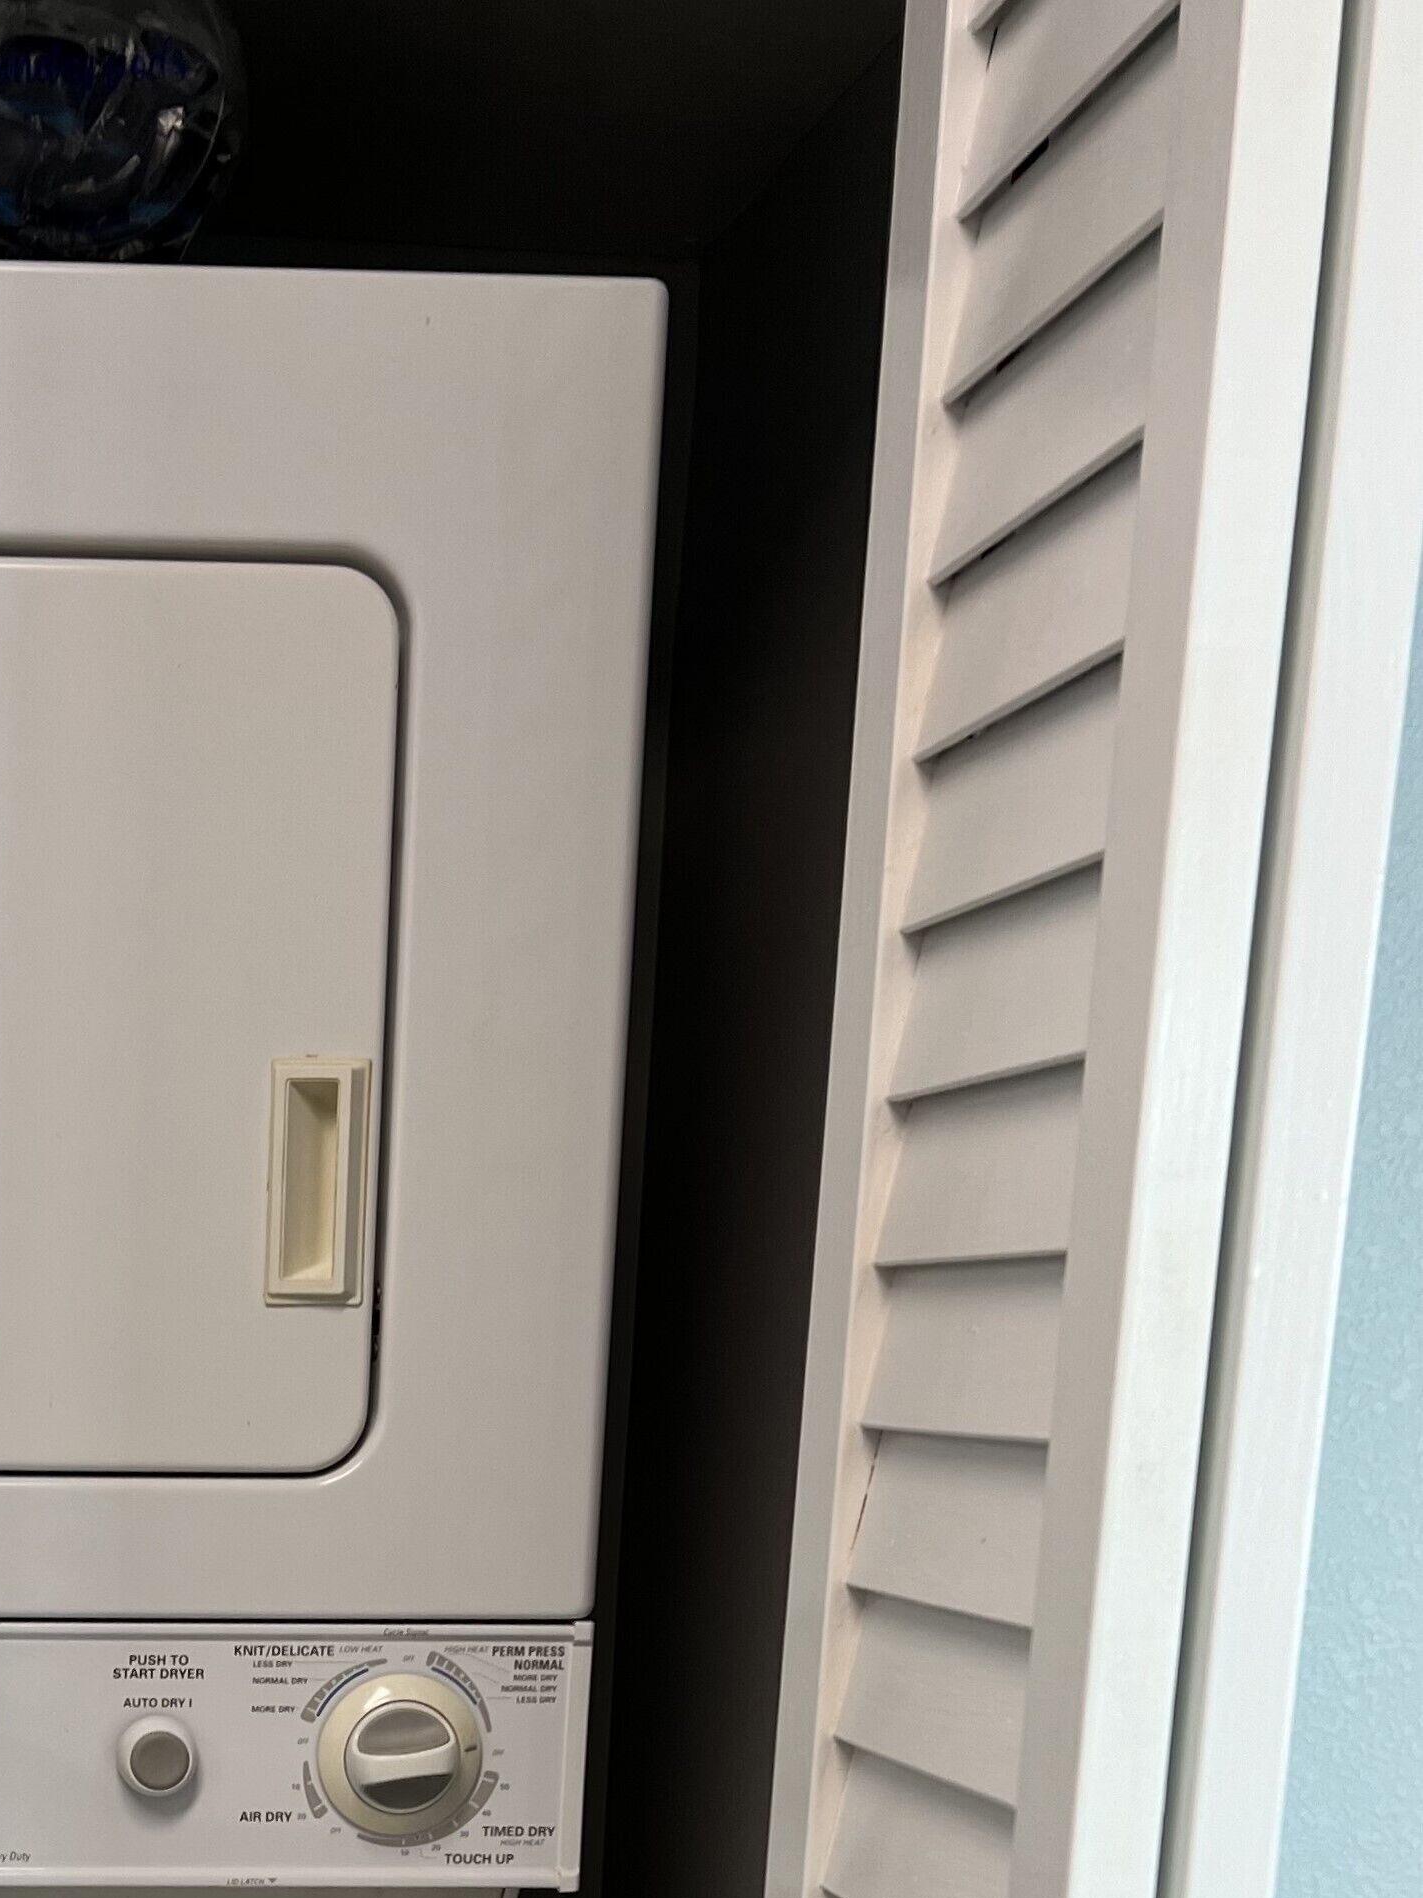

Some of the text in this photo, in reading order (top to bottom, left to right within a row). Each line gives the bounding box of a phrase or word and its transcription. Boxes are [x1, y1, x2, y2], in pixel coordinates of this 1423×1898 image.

[234, 1645, 335, 1657] KNIT/DELICATE
[339, 1645, 360, 1653] LOW
[492, 1646, 565, 1657] PERM PRESS
[129, 1655, 189, 1666] PUSH TO
[253, 1660, 293, 1668] LESS DRY
[514, 1659, 564, 1670] NORMAL
[113, 1668, 205, 1679] START DRYER
[252, 1677, 308, 1685] NORMAL DRY
[123, 1698, 158, 1708] AUTO
[161, 1698, 186, 1708] DRY
[516, 1696, 557, 1704] LESS DRY
[251, 1705, 295, 1713] MORE DRY
[240, 1811, 292, 1822] AIR DRY
[482, 1826, 556, 1837] TIMED DRY
[9, 1850, 31, 1862] Duty
[444, 1853, 514, 1864] TOUCH UP
